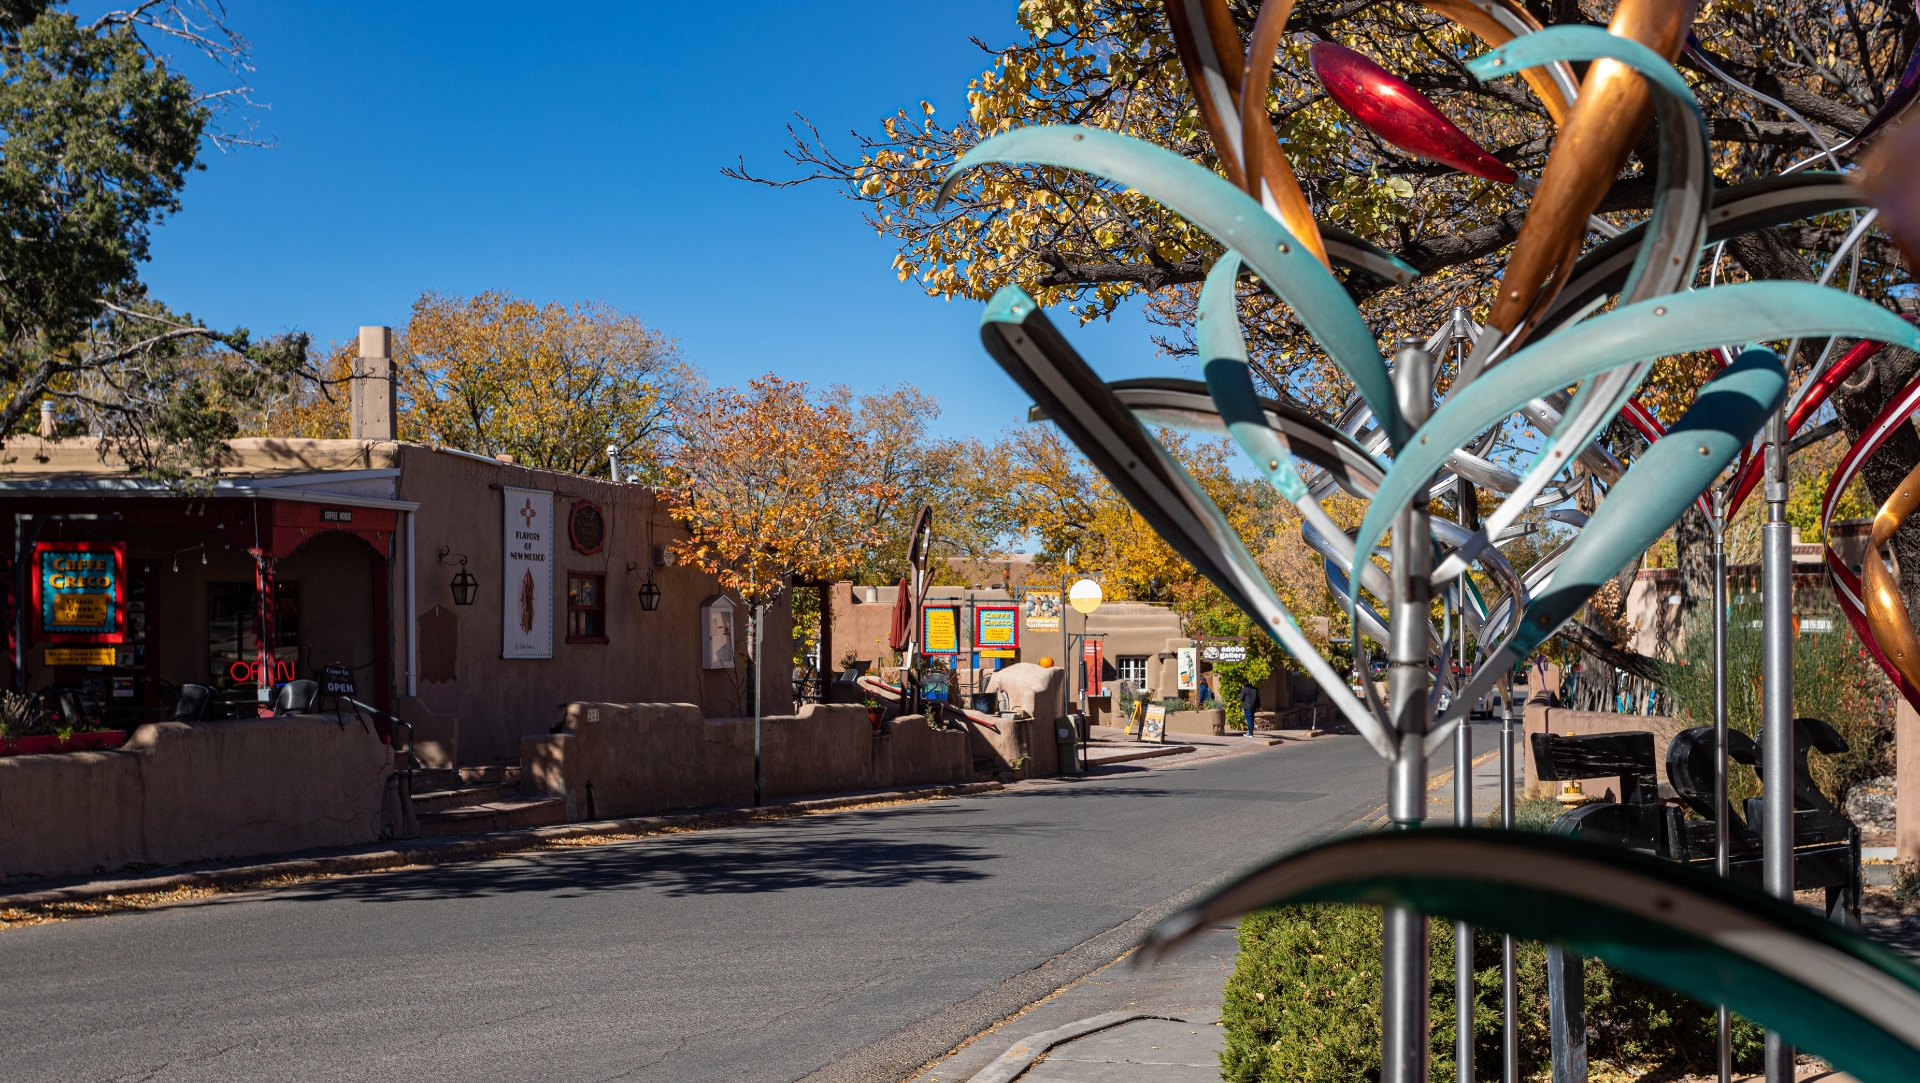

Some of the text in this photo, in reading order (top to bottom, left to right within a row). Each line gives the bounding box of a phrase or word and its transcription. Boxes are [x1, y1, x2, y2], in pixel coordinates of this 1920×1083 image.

[324, 511, 338, 521] COFFEE
[515, 531, 540, 541] FLAVORS
[524, 542, 532, 551] OF
[510, 552, 545, 562] NEW MEXICO
[1221, 645, 1245, 653] adobe
[1219, 652, 1246, 660] gallery
[327, 682, 354, 693] OPEN
